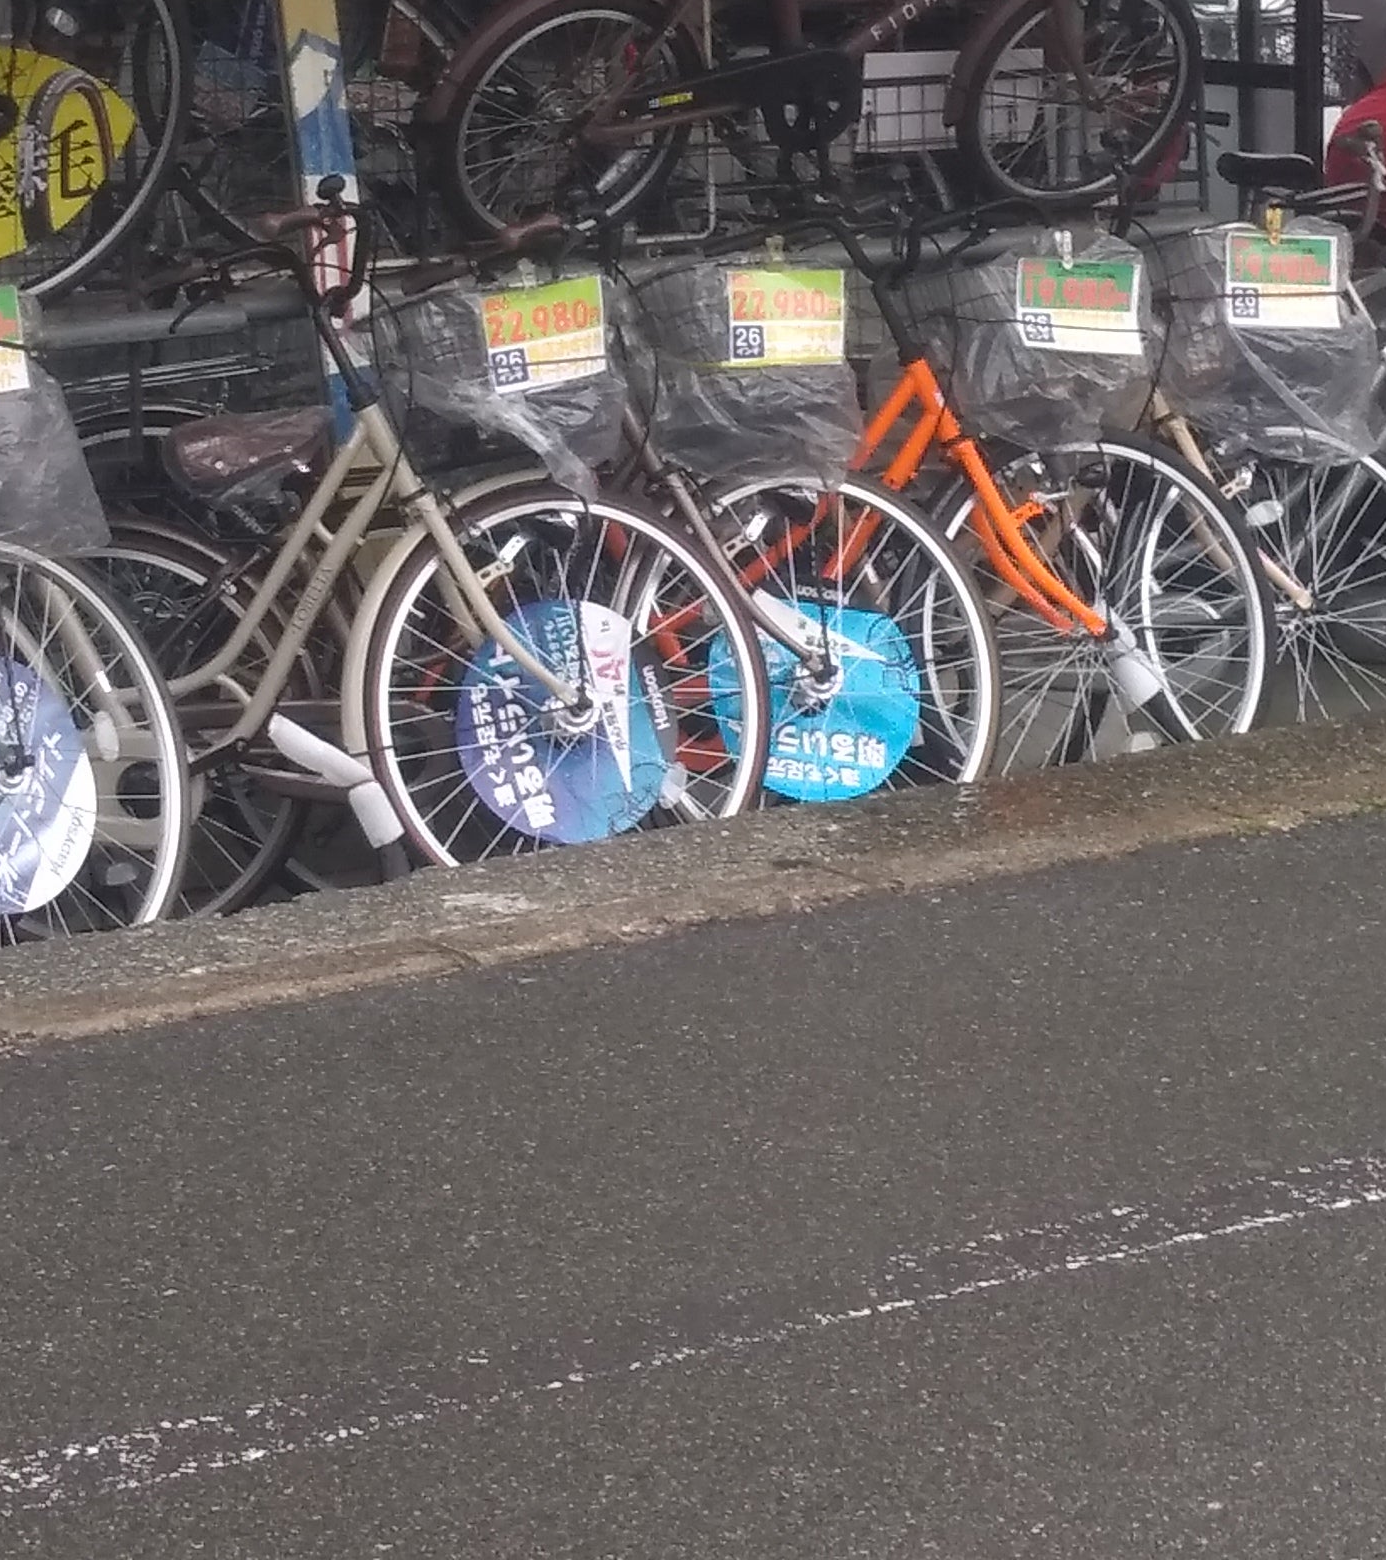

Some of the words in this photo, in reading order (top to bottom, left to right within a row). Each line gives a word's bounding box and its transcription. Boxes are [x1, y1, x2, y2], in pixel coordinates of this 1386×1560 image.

[734, 327, 762, 348] 26
[641, 664, 671, 731] Hapyson
[777, 724, 886, 769] 明るいラ
[766, 755, 862, 788] 遠くも足元
